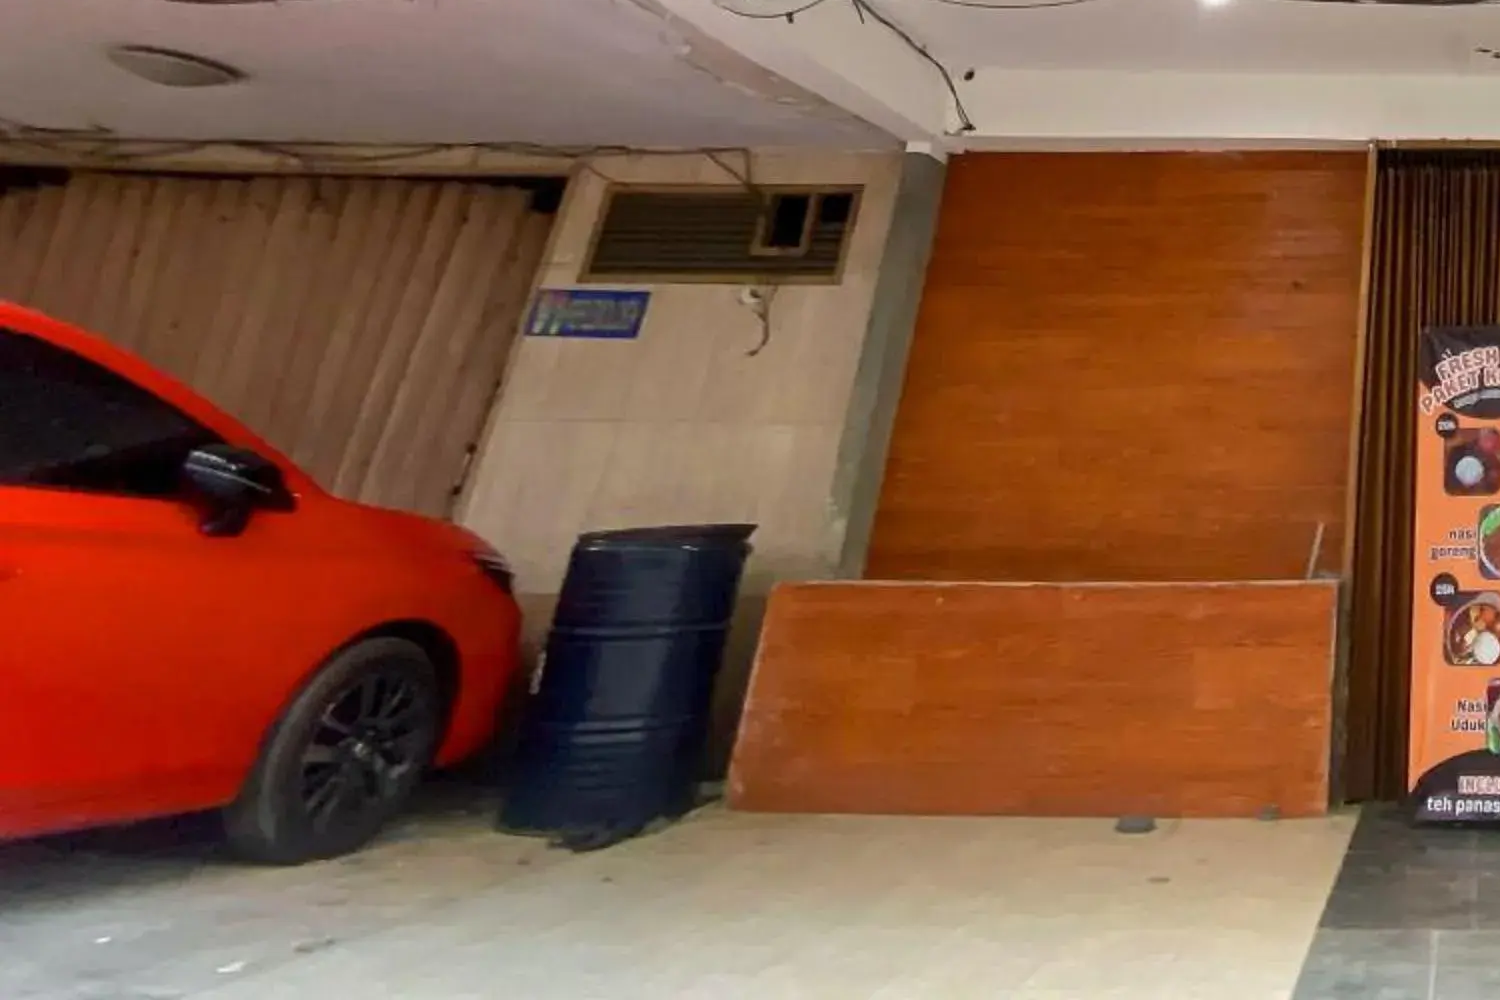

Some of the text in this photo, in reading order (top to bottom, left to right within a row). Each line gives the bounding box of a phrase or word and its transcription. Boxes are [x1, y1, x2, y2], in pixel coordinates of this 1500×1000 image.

[1436, 346, 1499, 381] FRESH
[1420, 369, 1480, 415] PAKET
[1451, 718, 1486, 731] Uduk
[1427, 797, 1451, 812] teh
